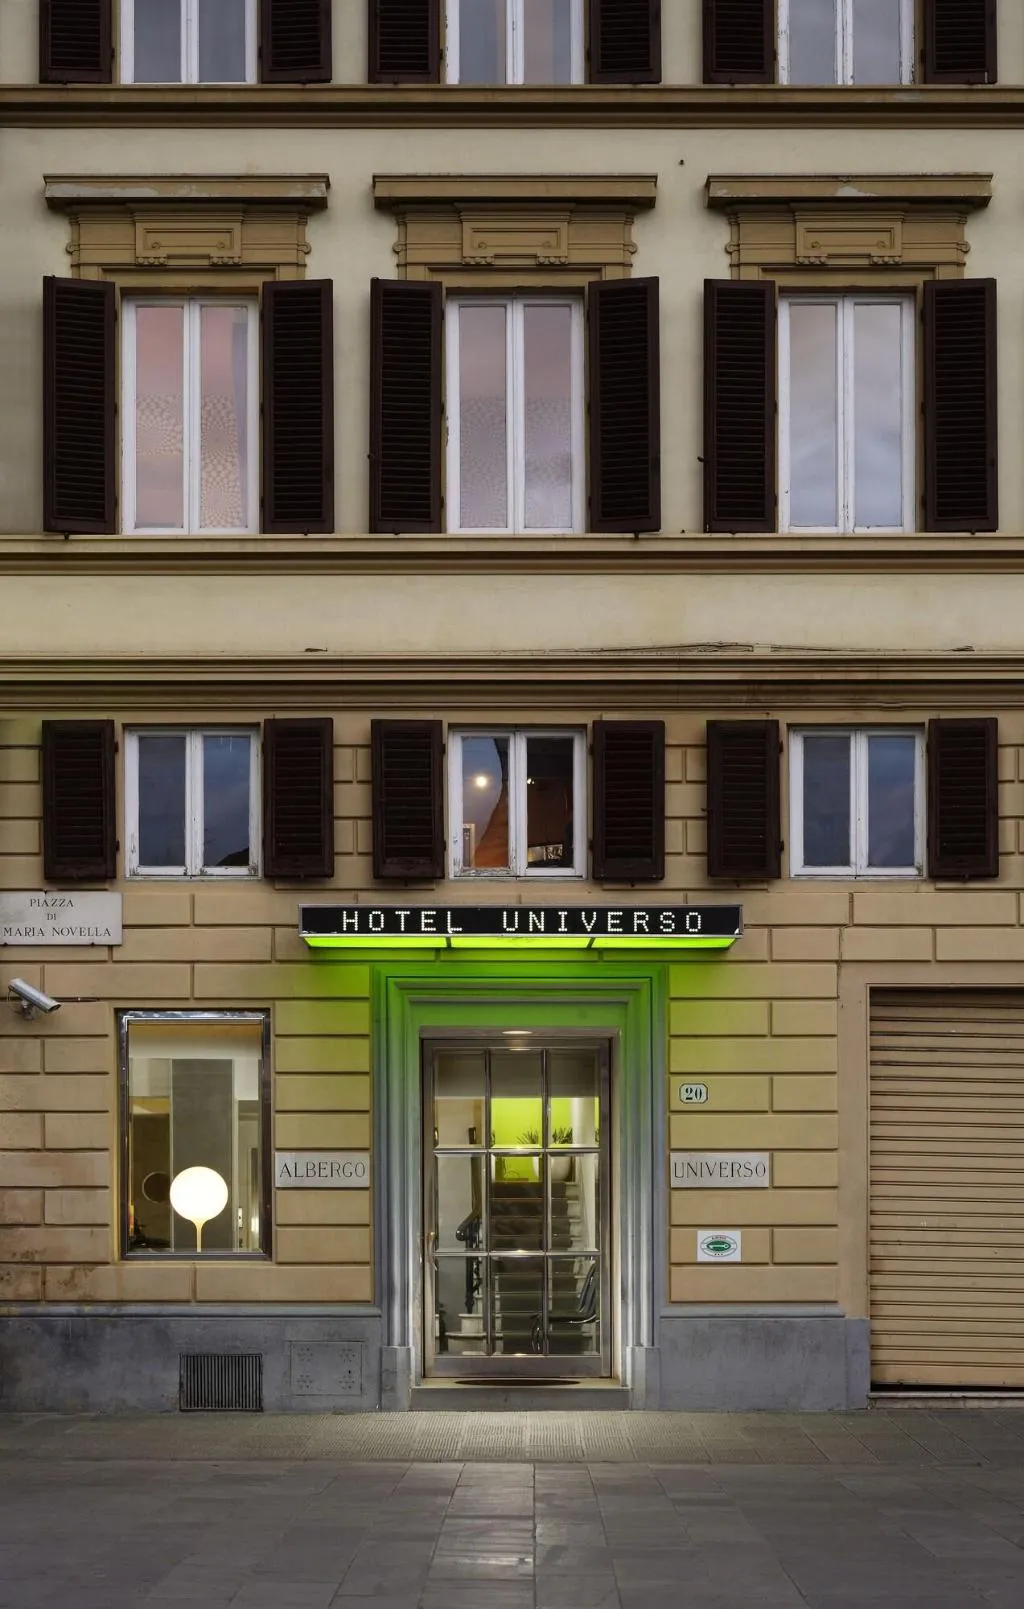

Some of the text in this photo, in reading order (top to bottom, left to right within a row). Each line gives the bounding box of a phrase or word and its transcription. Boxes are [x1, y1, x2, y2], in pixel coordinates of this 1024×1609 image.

[30, 898, 74, 908] PIAZZA
[47, 913, 57, 921] DI
[342, 910, 702, 933] HOTEL UNIVERSO
[3, 927, 112, 937] MARIA NOVELLA
[685, 1087, 703, 1101] 20
[279, 1161, 366, 1178] ALBERGO
[673, 1161, 767, 1179] UNIVERSO
